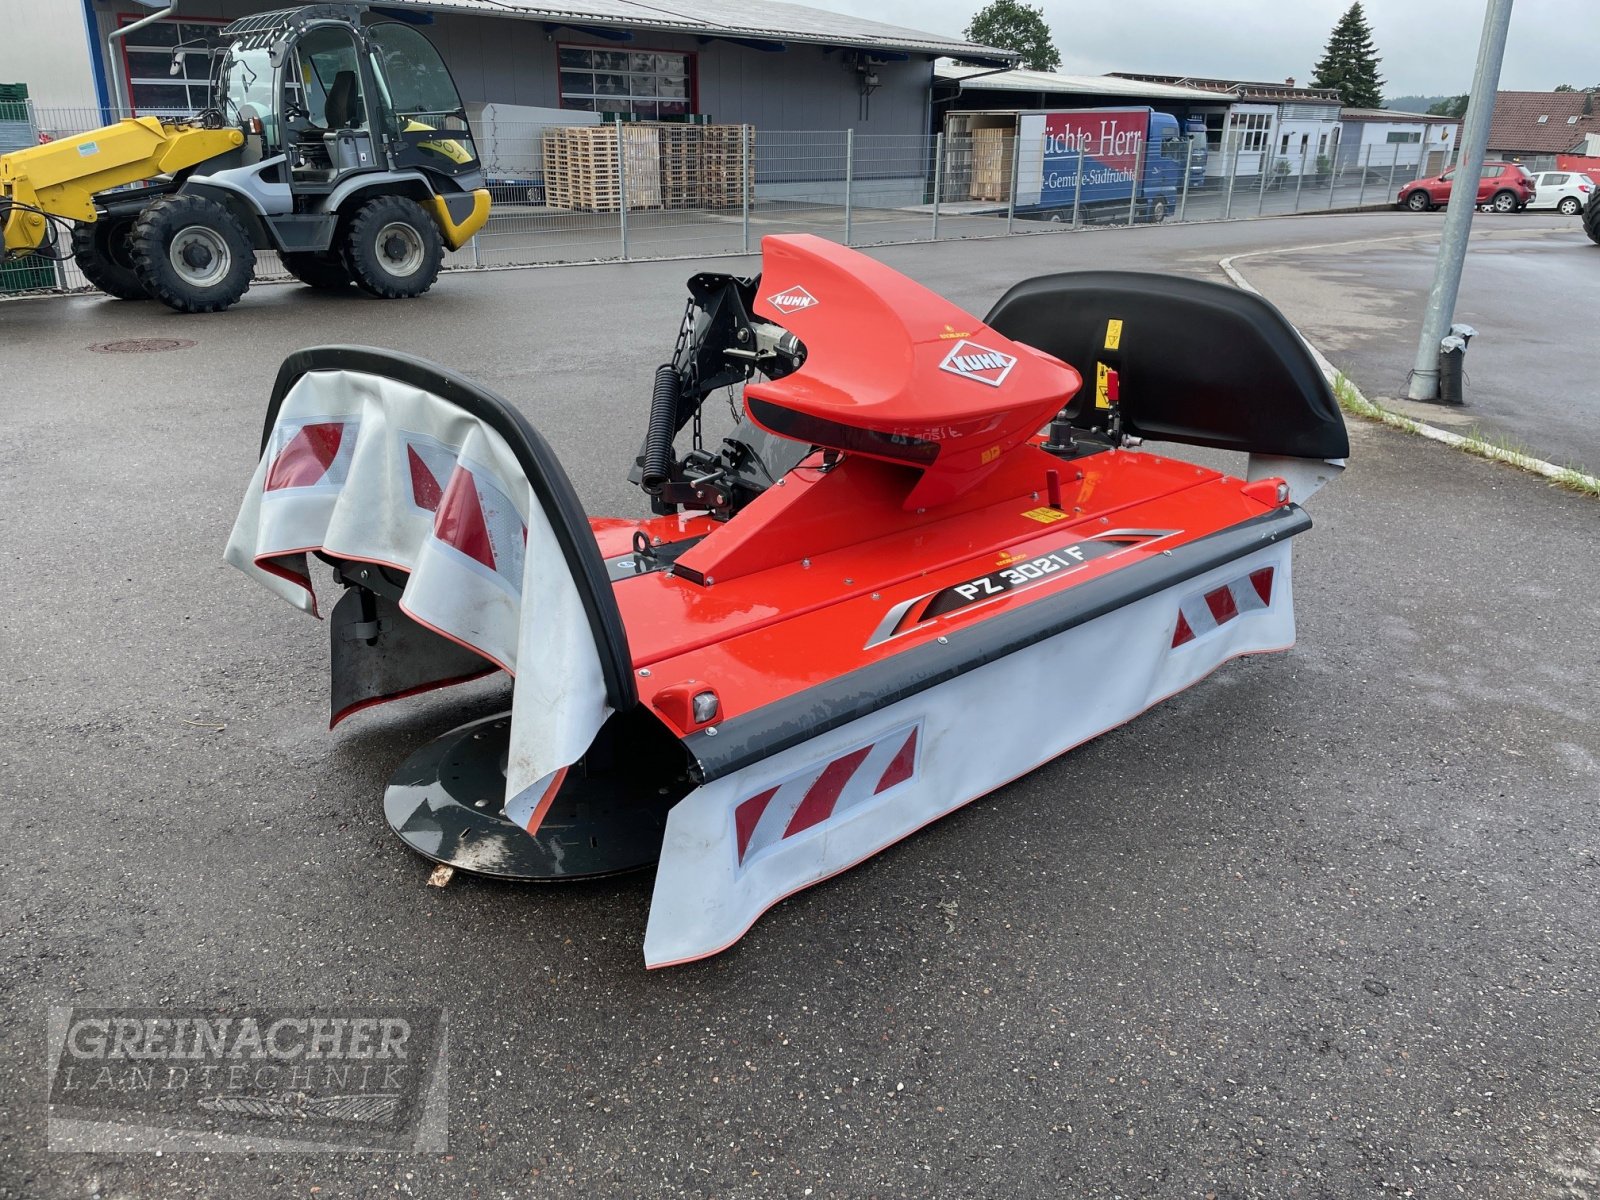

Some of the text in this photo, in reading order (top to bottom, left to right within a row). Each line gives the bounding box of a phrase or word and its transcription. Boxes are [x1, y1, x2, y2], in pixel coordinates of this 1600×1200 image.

[1100, 120, 1141, 156] Herr
[774, 295, 811, 307] KUHN
[951, 352, 1009, 373] KUHN
[954, 577, 1005, 601] PZ
[999, 554, 1070, 585] 3021
[1063, 545, 1084, 561] F
